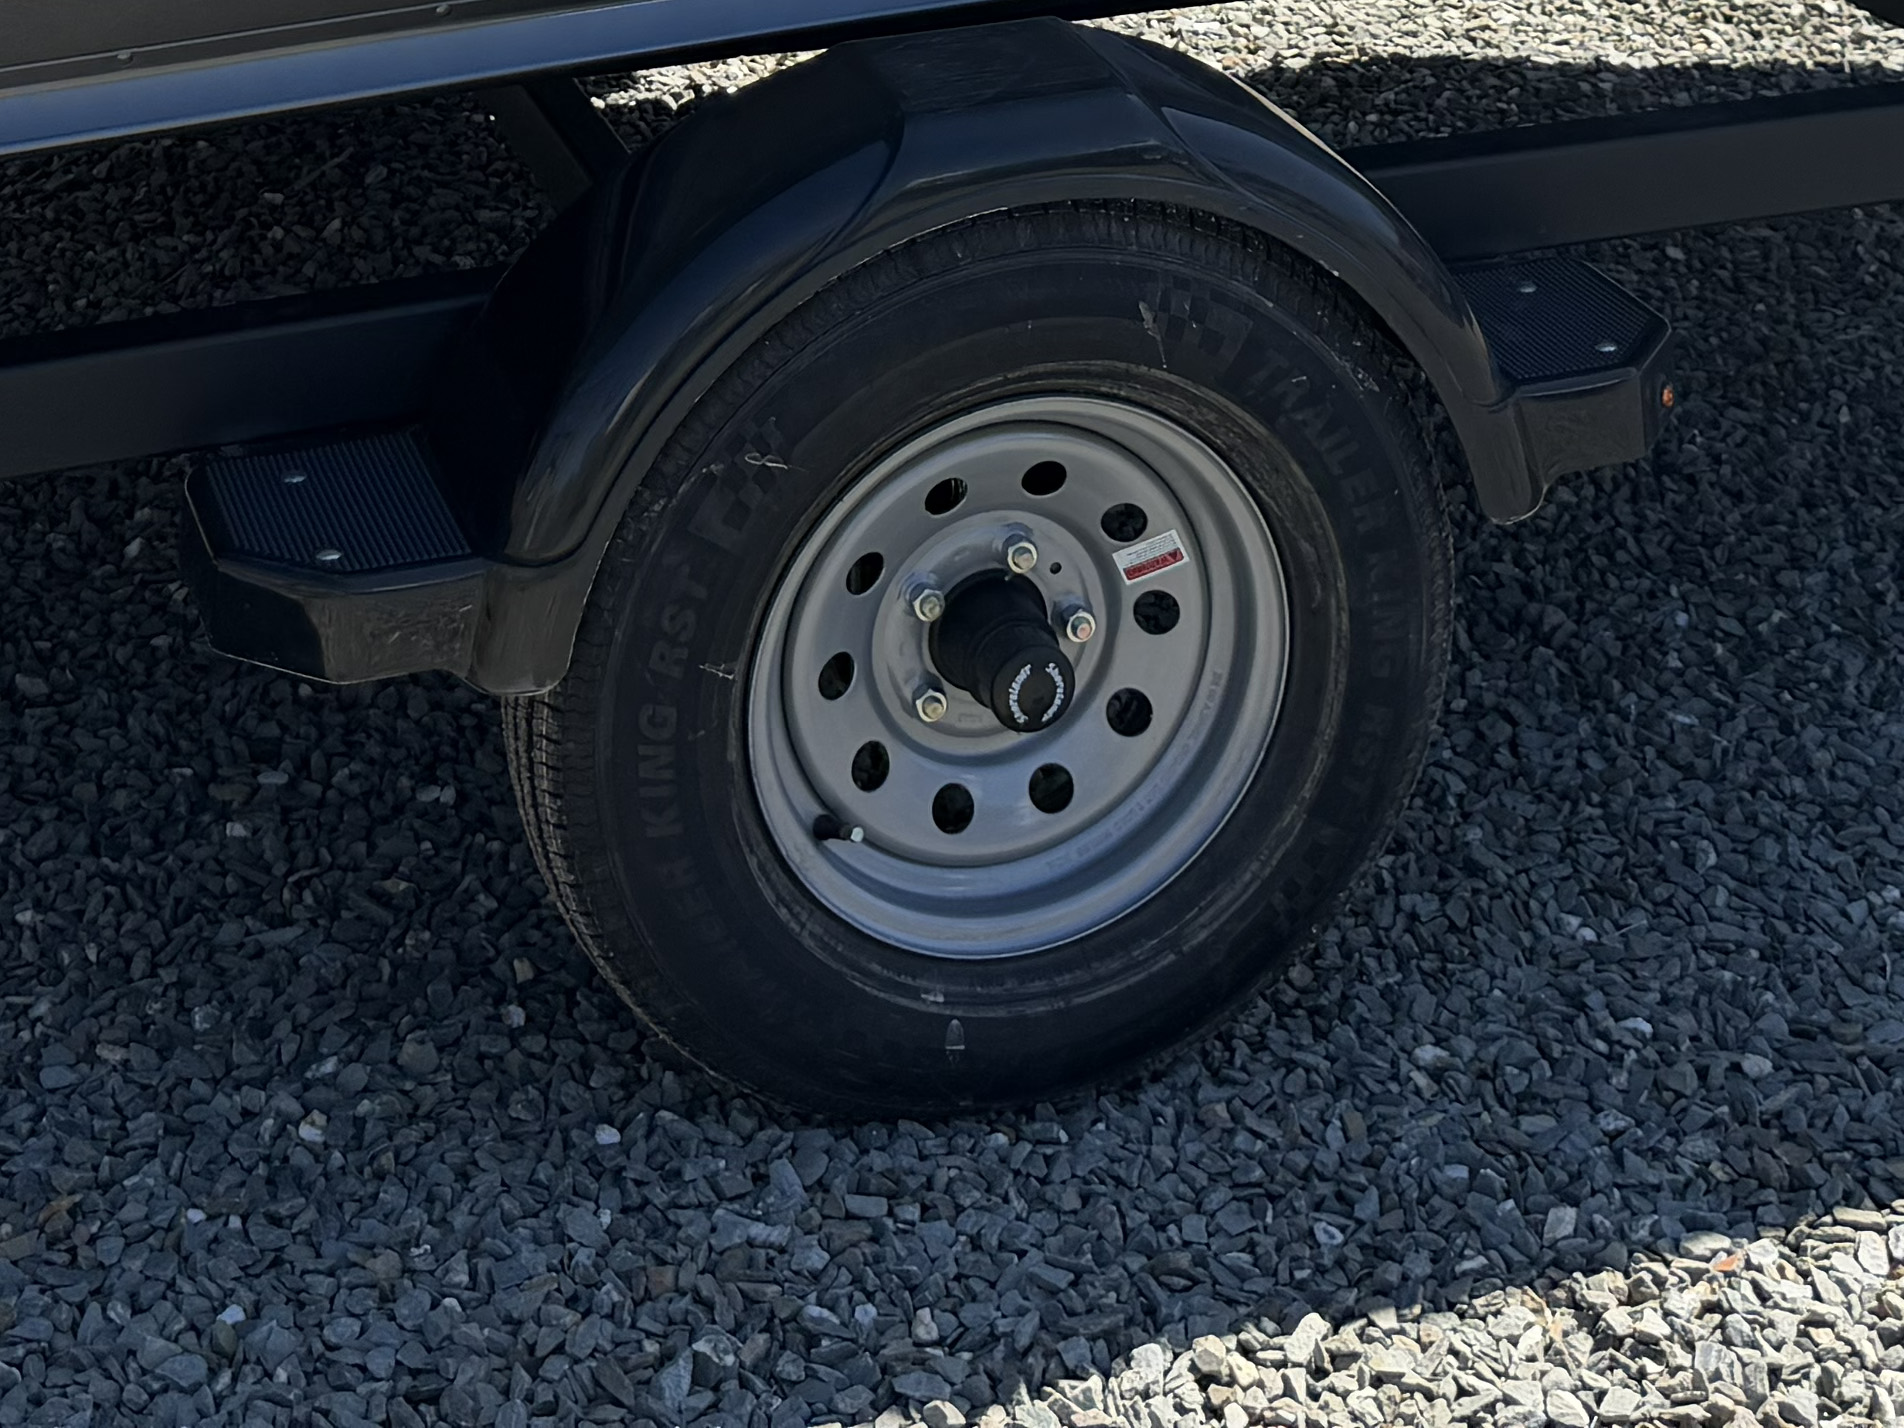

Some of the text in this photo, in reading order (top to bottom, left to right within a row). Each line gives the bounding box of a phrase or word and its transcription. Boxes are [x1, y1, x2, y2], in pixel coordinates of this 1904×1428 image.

[1246, 348, 1388, 536] TRAILER
[1368, 546, 1411, 679] KING
[648, 556, 716, 681] RST
[636, 701, 684, 840] KING
